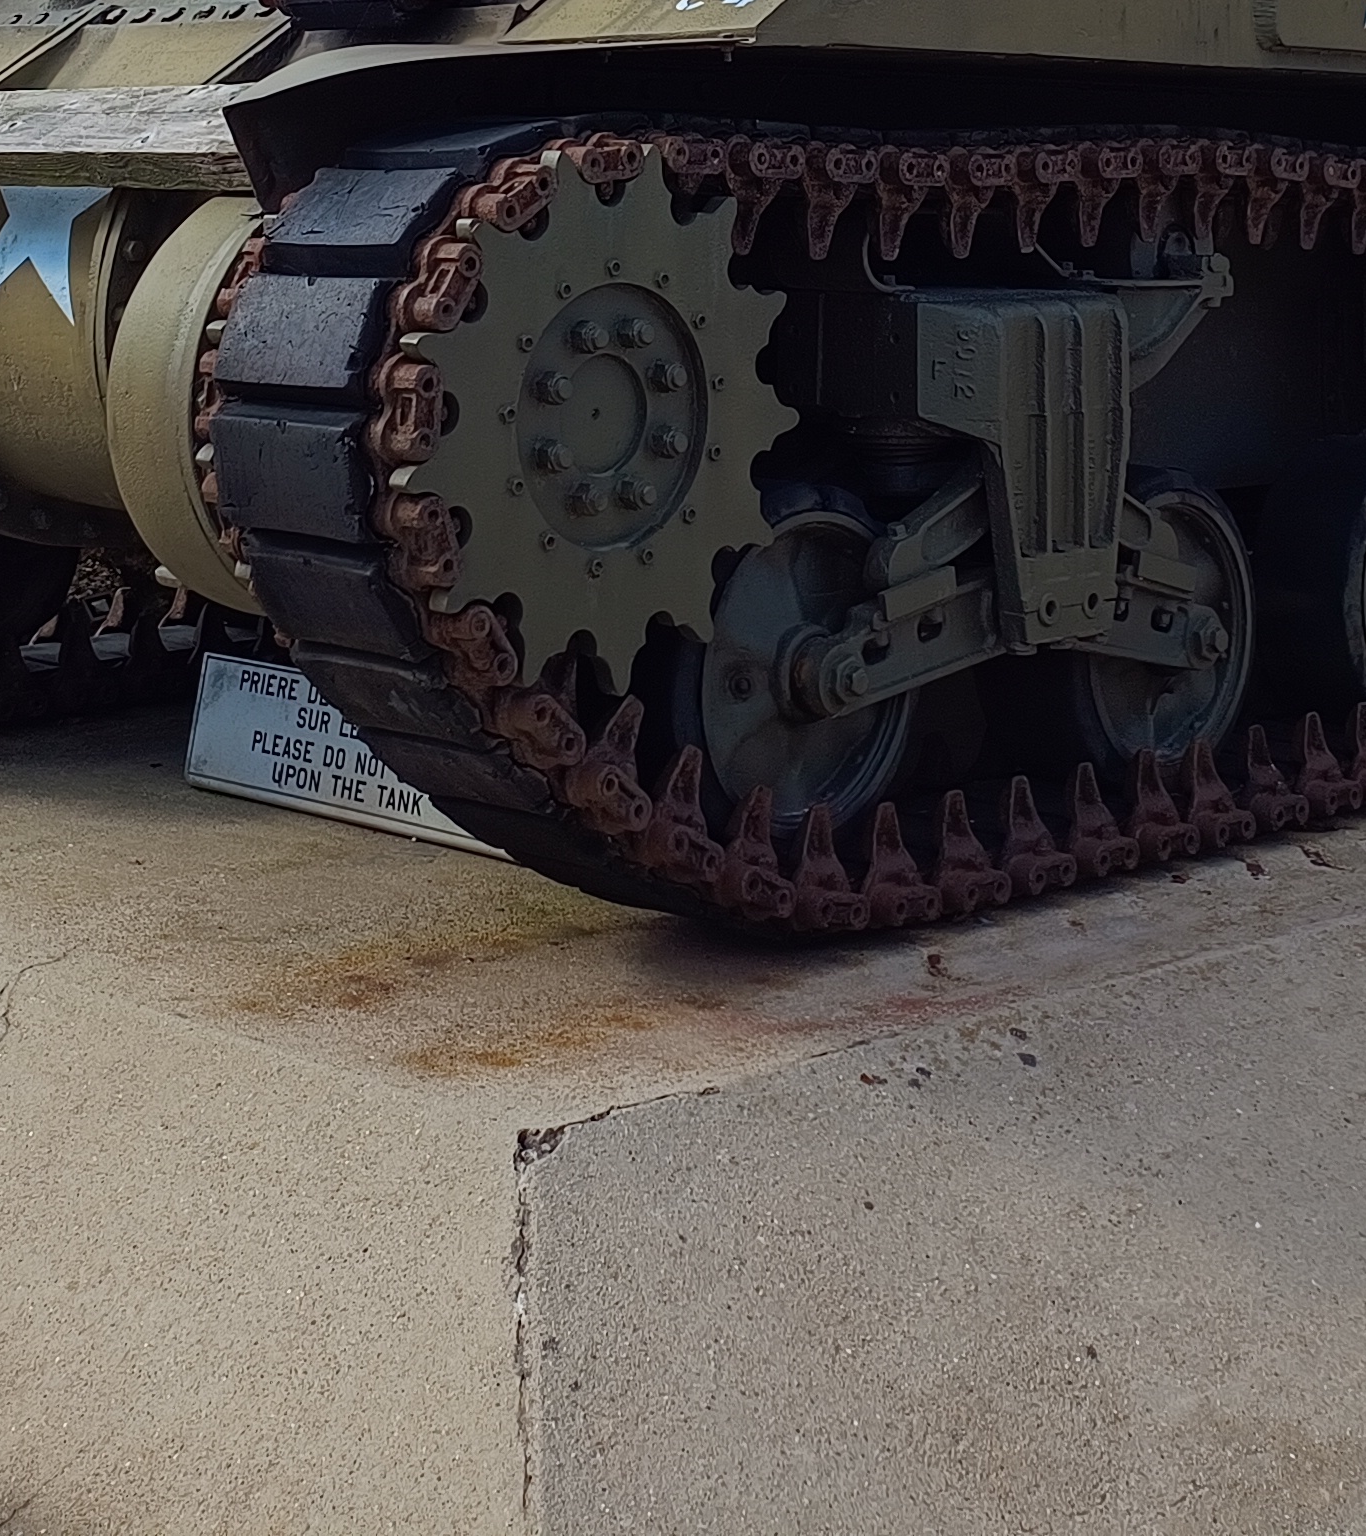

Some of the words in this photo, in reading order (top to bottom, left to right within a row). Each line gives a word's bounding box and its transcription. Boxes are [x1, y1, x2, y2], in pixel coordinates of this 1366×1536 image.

[296, 707, 331, 734] SUR
[251, 730, 315, 764] PLEASE
[323, 745, 346, 770] DO
[272, 761, 322, 793] UPON
[331, 774, 367, 803] THE
[377, 784, 424, 817] TANK
